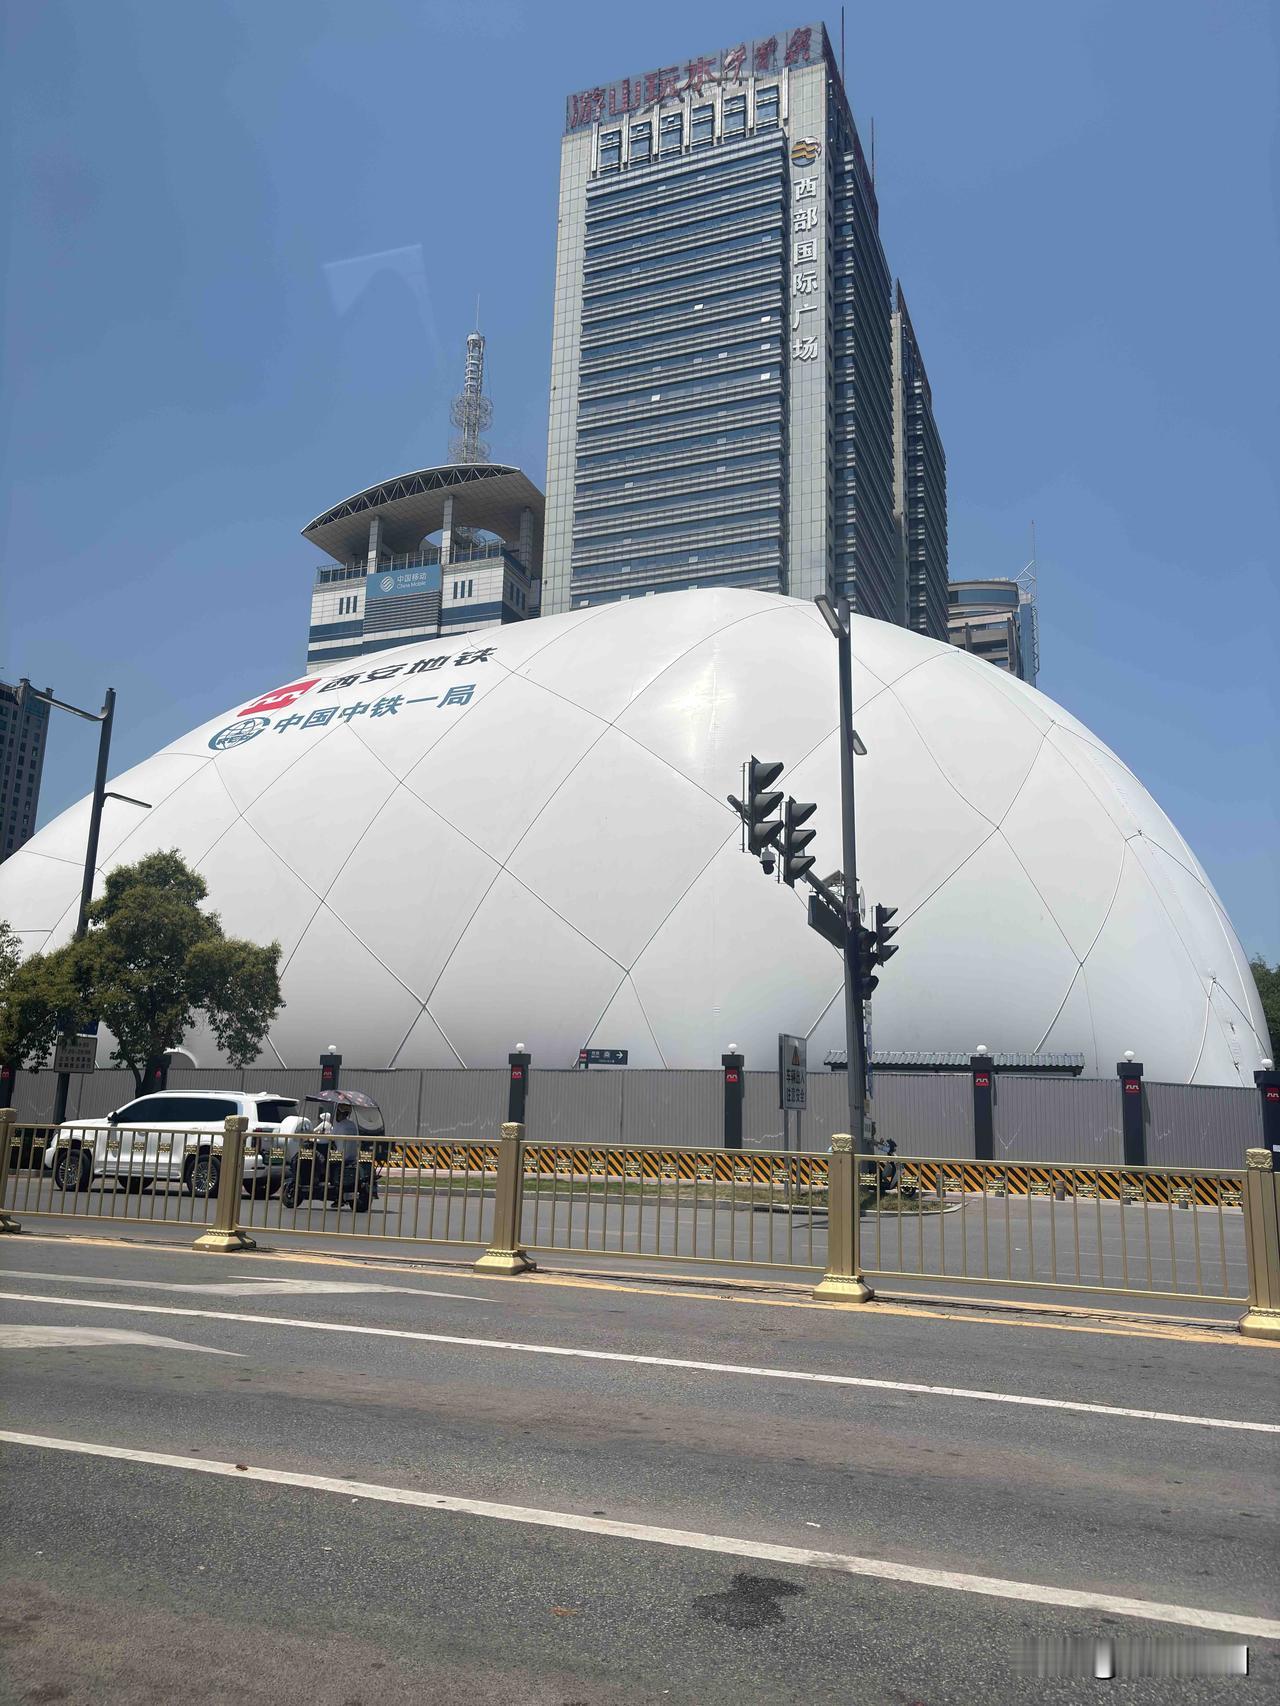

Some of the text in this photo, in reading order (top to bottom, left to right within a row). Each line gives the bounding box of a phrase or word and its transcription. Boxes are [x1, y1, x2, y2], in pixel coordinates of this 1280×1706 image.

[792, 174, 819, 362] 西部国际广场
[397, 572, 427, 583] 中国移动
[317, 647, 498, 693] 西安地铁
[272, 683, 477, 734] 中国中铁一局
